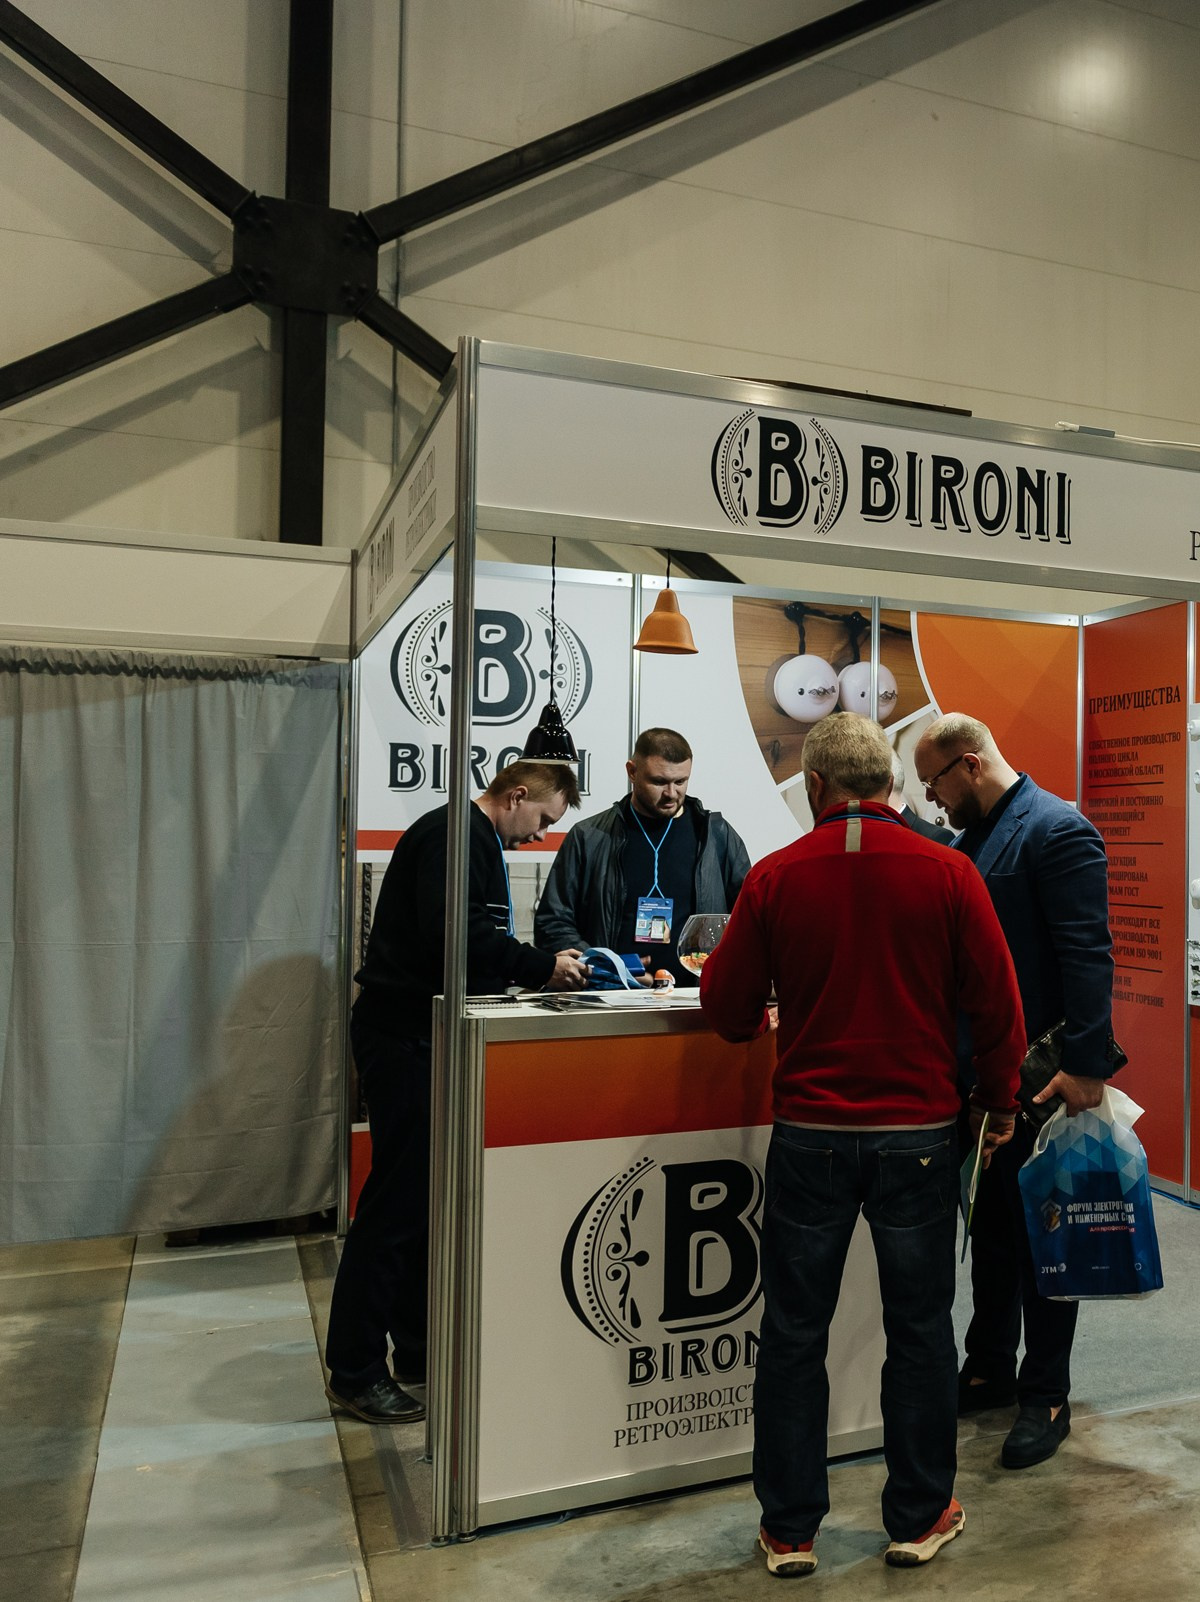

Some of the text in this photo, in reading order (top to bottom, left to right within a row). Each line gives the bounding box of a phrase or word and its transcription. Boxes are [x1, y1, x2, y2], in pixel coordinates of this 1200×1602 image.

[860, 444, 1073, 545] BIRONI
[1088, 685, 1181, 715] ПРЕИМУЩЕСТВА
[1131, 731, 1181, 746] ПРОИЗВОДСТВО
[1117, 751, 1139, 763] ЦИКЛА
[1135, 764, 1164, 775] ОБЛАСТИ
[1124, 886, 1140, 897] ГОСТ
[1149, 918, 1161, 929] ВСЕ
[1066, 1202, 1093, 1214] ФОРУМ
[1074, 1212, 1120, 1224] ИНЖЕНЕРНЫХ
